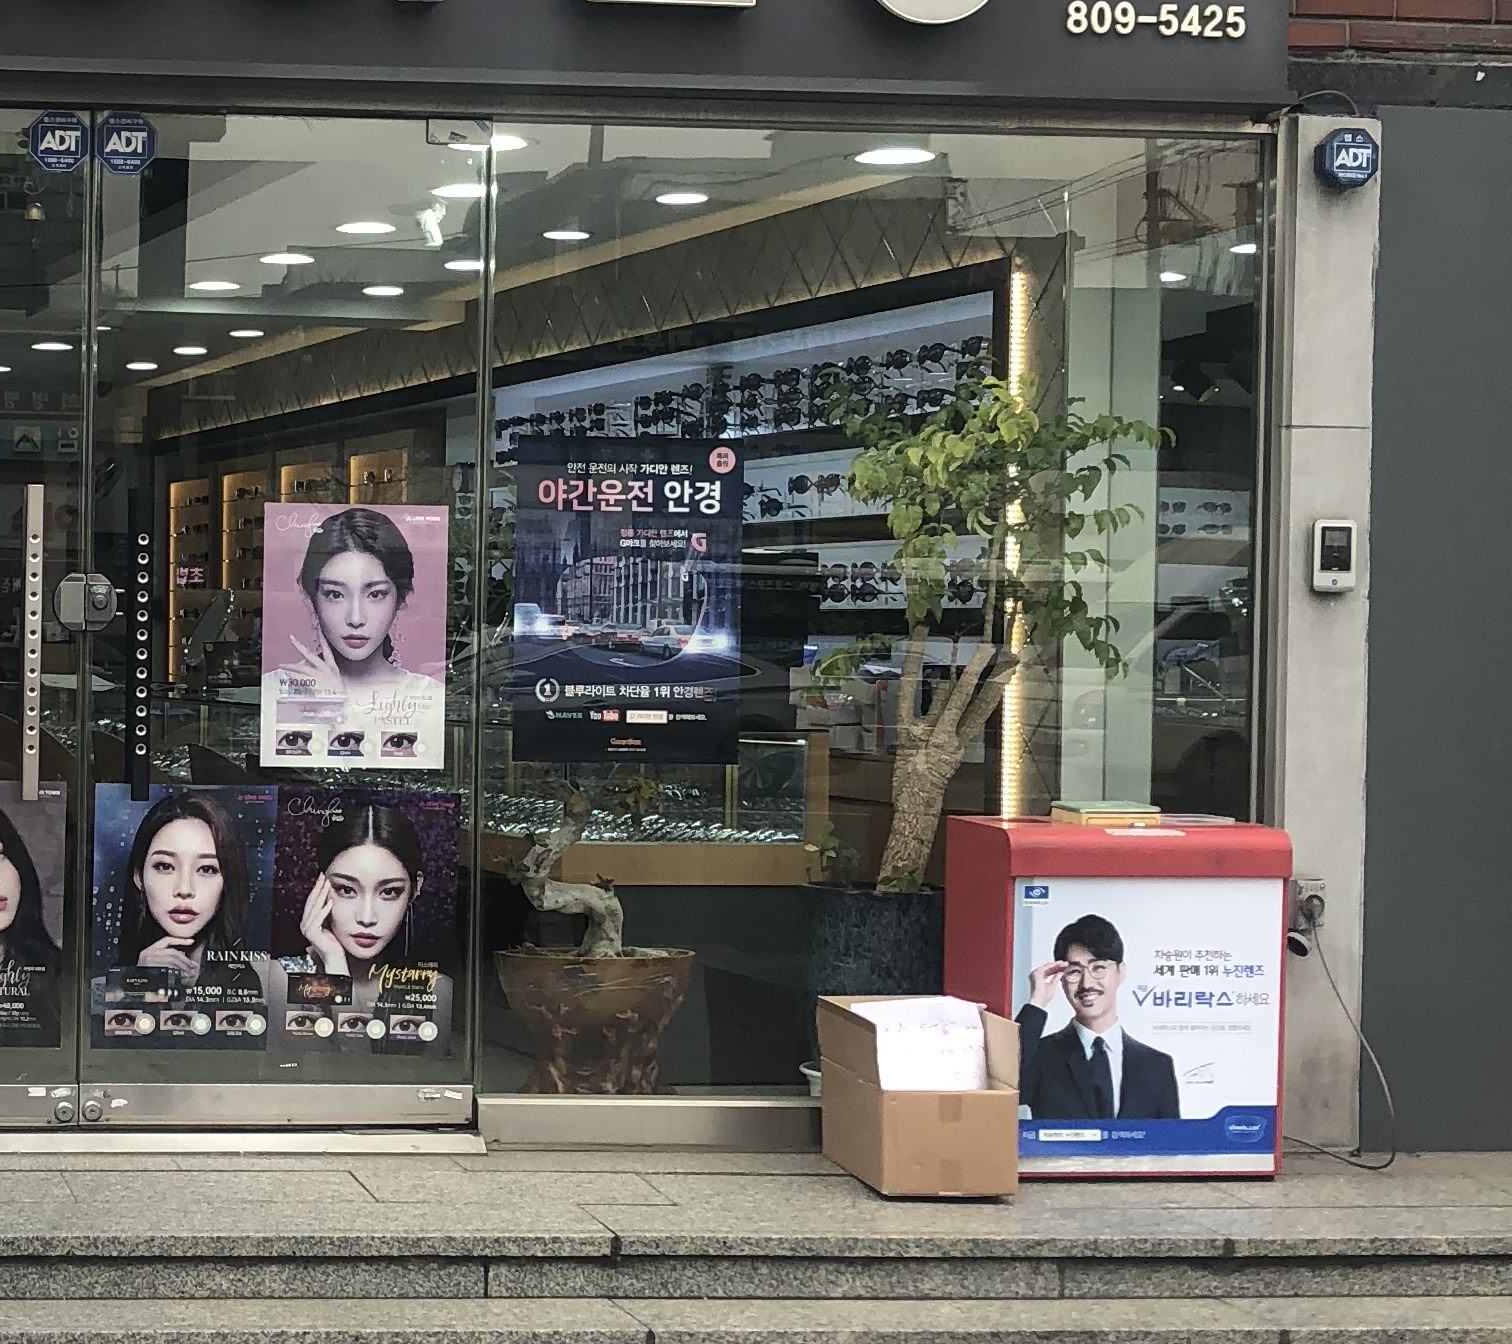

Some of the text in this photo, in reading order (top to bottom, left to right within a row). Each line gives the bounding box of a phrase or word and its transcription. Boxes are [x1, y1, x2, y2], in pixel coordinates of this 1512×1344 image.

[1065, 0, 1248, 39] 809-5425
[39, 129, 82, 152] ADT
[104, 130, 148, 154] ADT
[1334, 147, 1372, 168] ADT
[566, 462, 586, 474] 안전
[587, 462, 616, 475] 운전의
[618, 463, 638, 475] 시작
[640, 463, 669, 476] 가디안
[537, 477, 723, 515] 야간운전 안경
[564, 684, 617, 699] 블루라이트
[619, 684, 651, 699] 차단율
[653, 686, 671, 699] 1위
[555, 711, 584, 719] NAVER
[206, 949, 269, 963] RAIN KISS
[1154, 949, 1233, 962] 차승원이 추천하는
[1153, 964, 1265, 978] 세계 판매 1위 누진렌즈
[1152, 989, 1271, 1009] 바리락스 하세요
